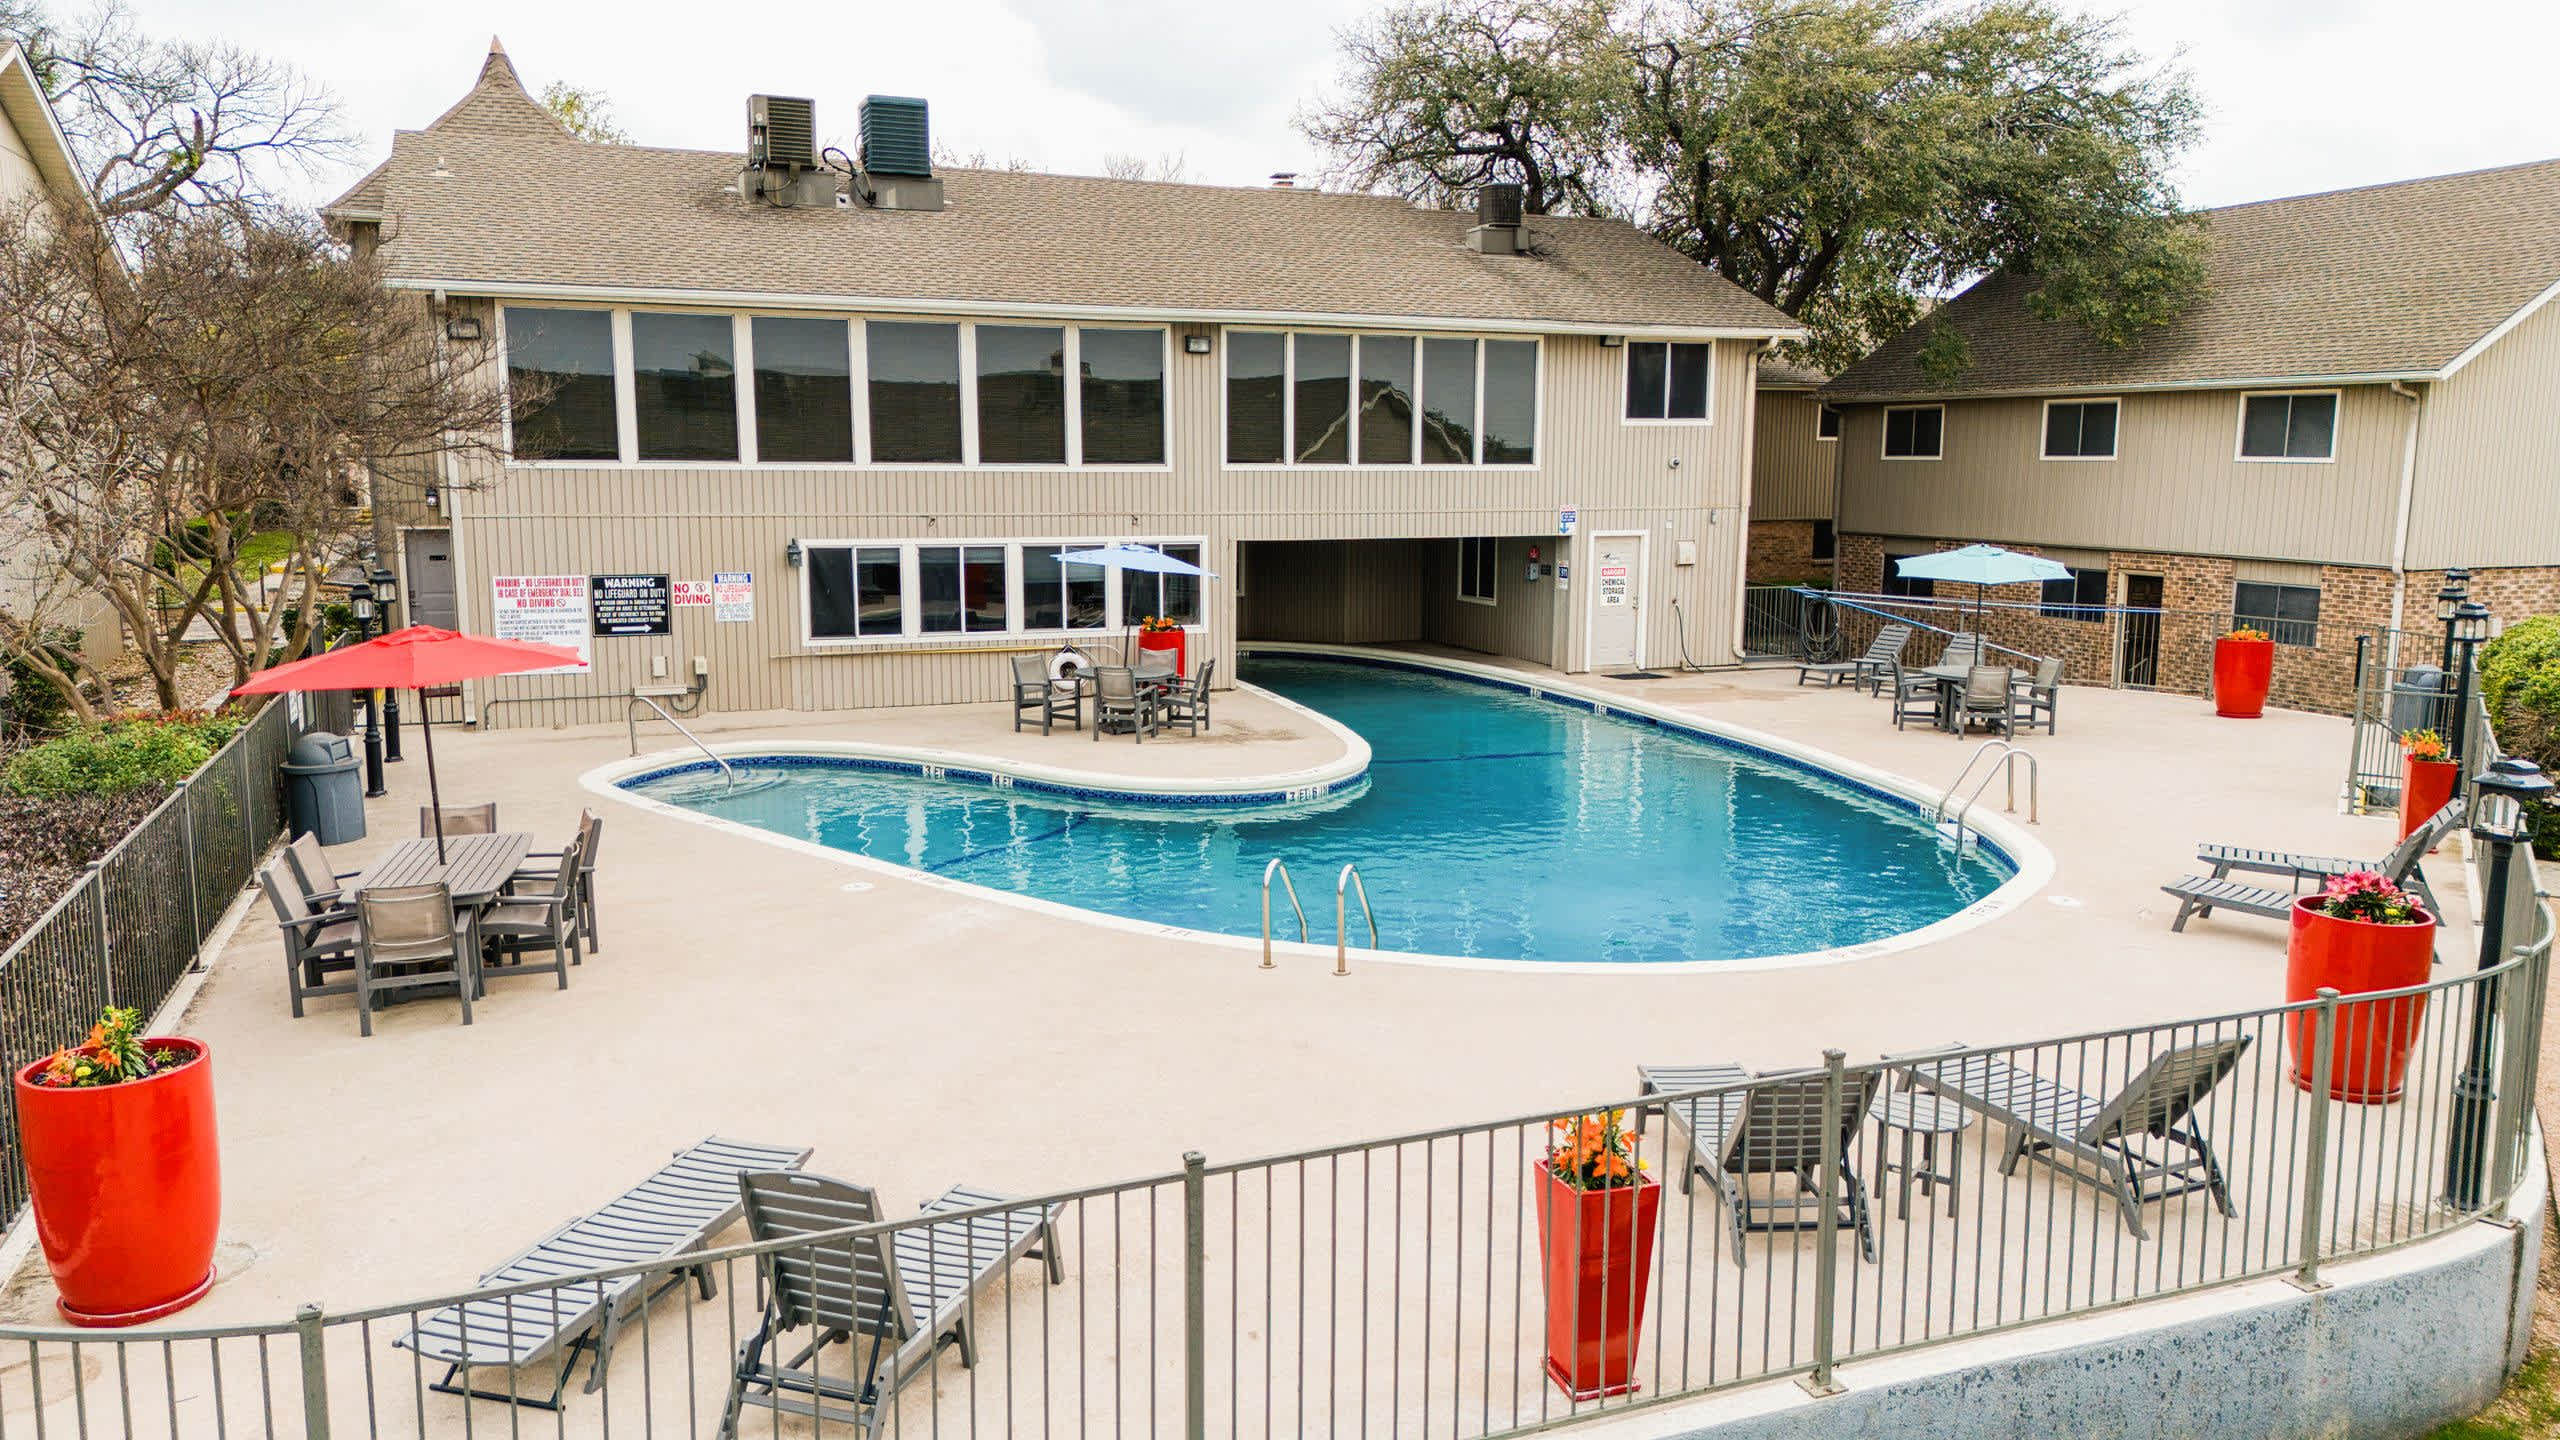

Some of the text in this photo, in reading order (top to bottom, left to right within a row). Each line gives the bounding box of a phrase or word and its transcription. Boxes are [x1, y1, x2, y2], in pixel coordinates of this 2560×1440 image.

[496, 578, 520, 587] WARNING
[534, 578, 562, 587] LIFEGUARD
[604, 578, 655, 588] WARNING
[718, 574, 748, 583] WARNING
[1602, 578, 1625, 586] CHEMICAL
[504, 589, 518, 597] CASE
[519, 589, 526, 597] OF
[528, 588, 559, 597] EMERGENCY
[673, 583, 689, 593] NO
[594, 588, 666, 599] NO LIFEGUARD ON DUTY
[516, 599, 555, 608] NO DIVING
[674, 594, 711, 604] DIVING
